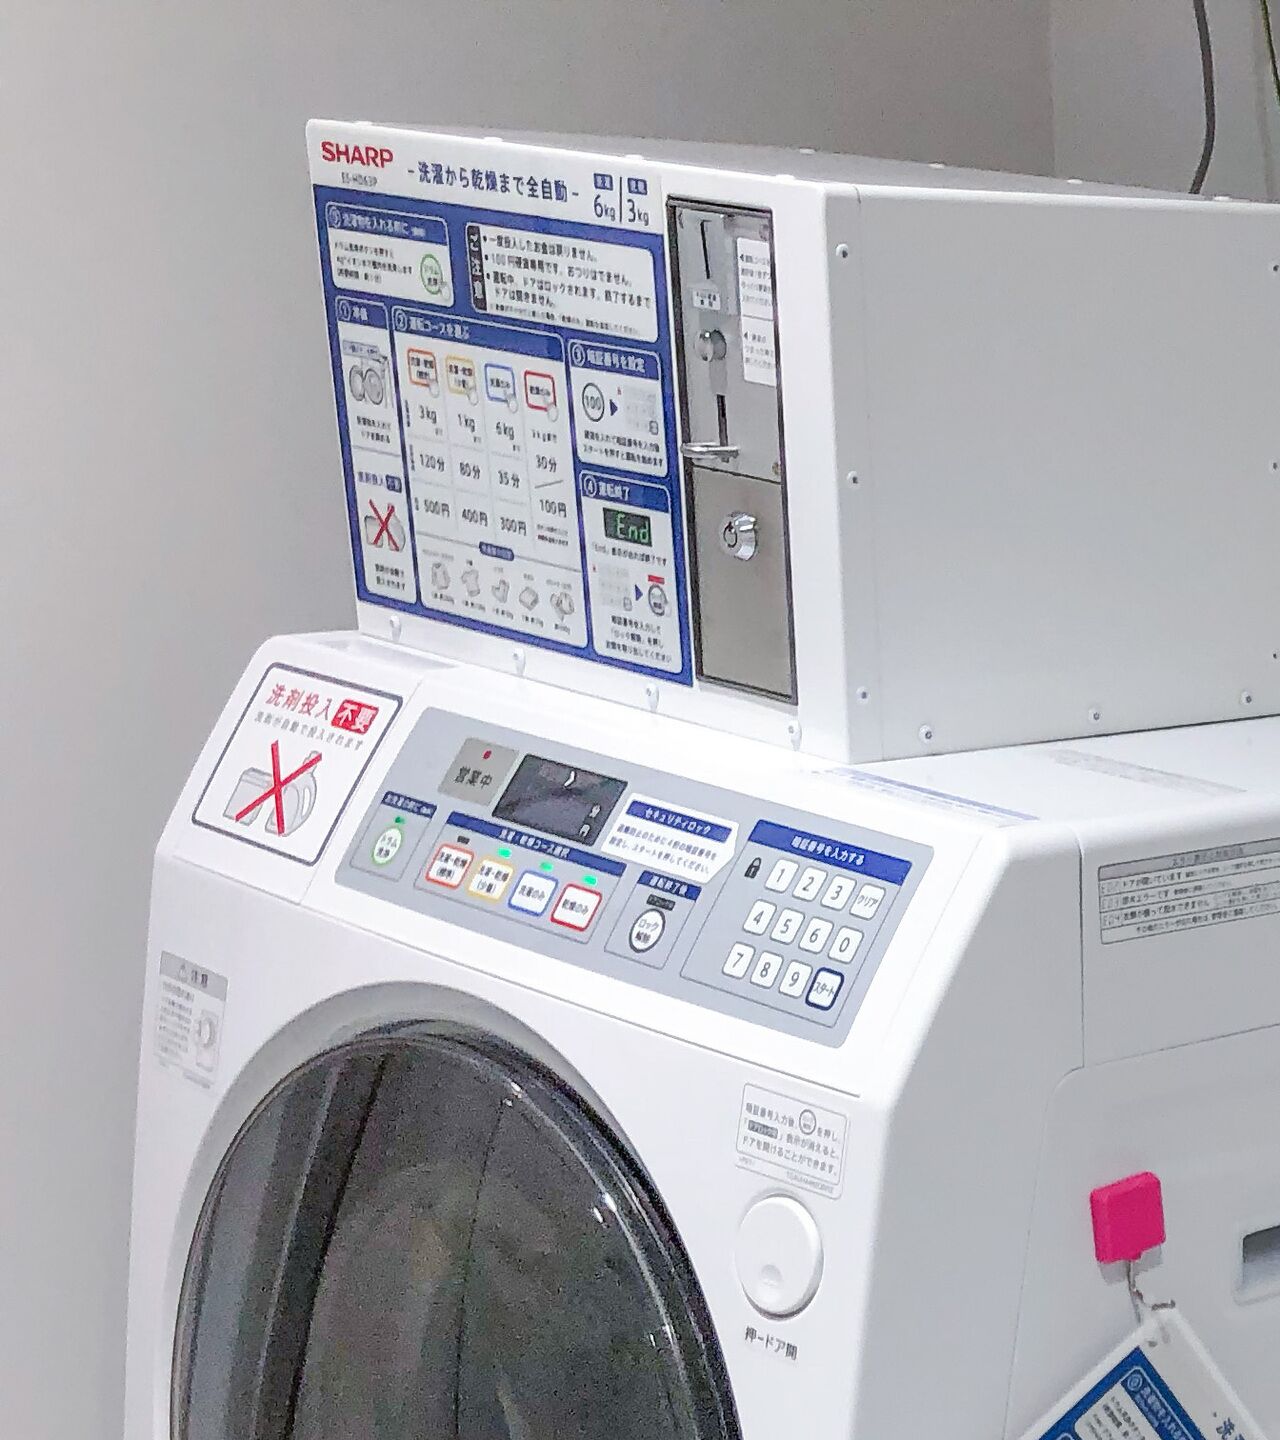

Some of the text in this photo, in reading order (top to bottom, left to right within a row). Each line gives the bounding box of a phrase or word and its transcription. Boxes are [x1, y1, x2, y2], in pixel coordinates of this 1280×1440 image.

[322, 141, 393, 168] SHARP
[593, 195, 650, 226] 6kg 3kg
[616, 513, 649, 543] End
[266, 684, 333, 722] 洗剤投入
[777, 868, 785, 883] 1
[802, 876, 810, 892] 2
[831, 885, 840, 901] 3
[753, 912, 849, 953] 4 5 6 0
[733, 953, 743, 968] 7
[761, 962, 770, 978] 8
[789, 971, 799, 987] 9
